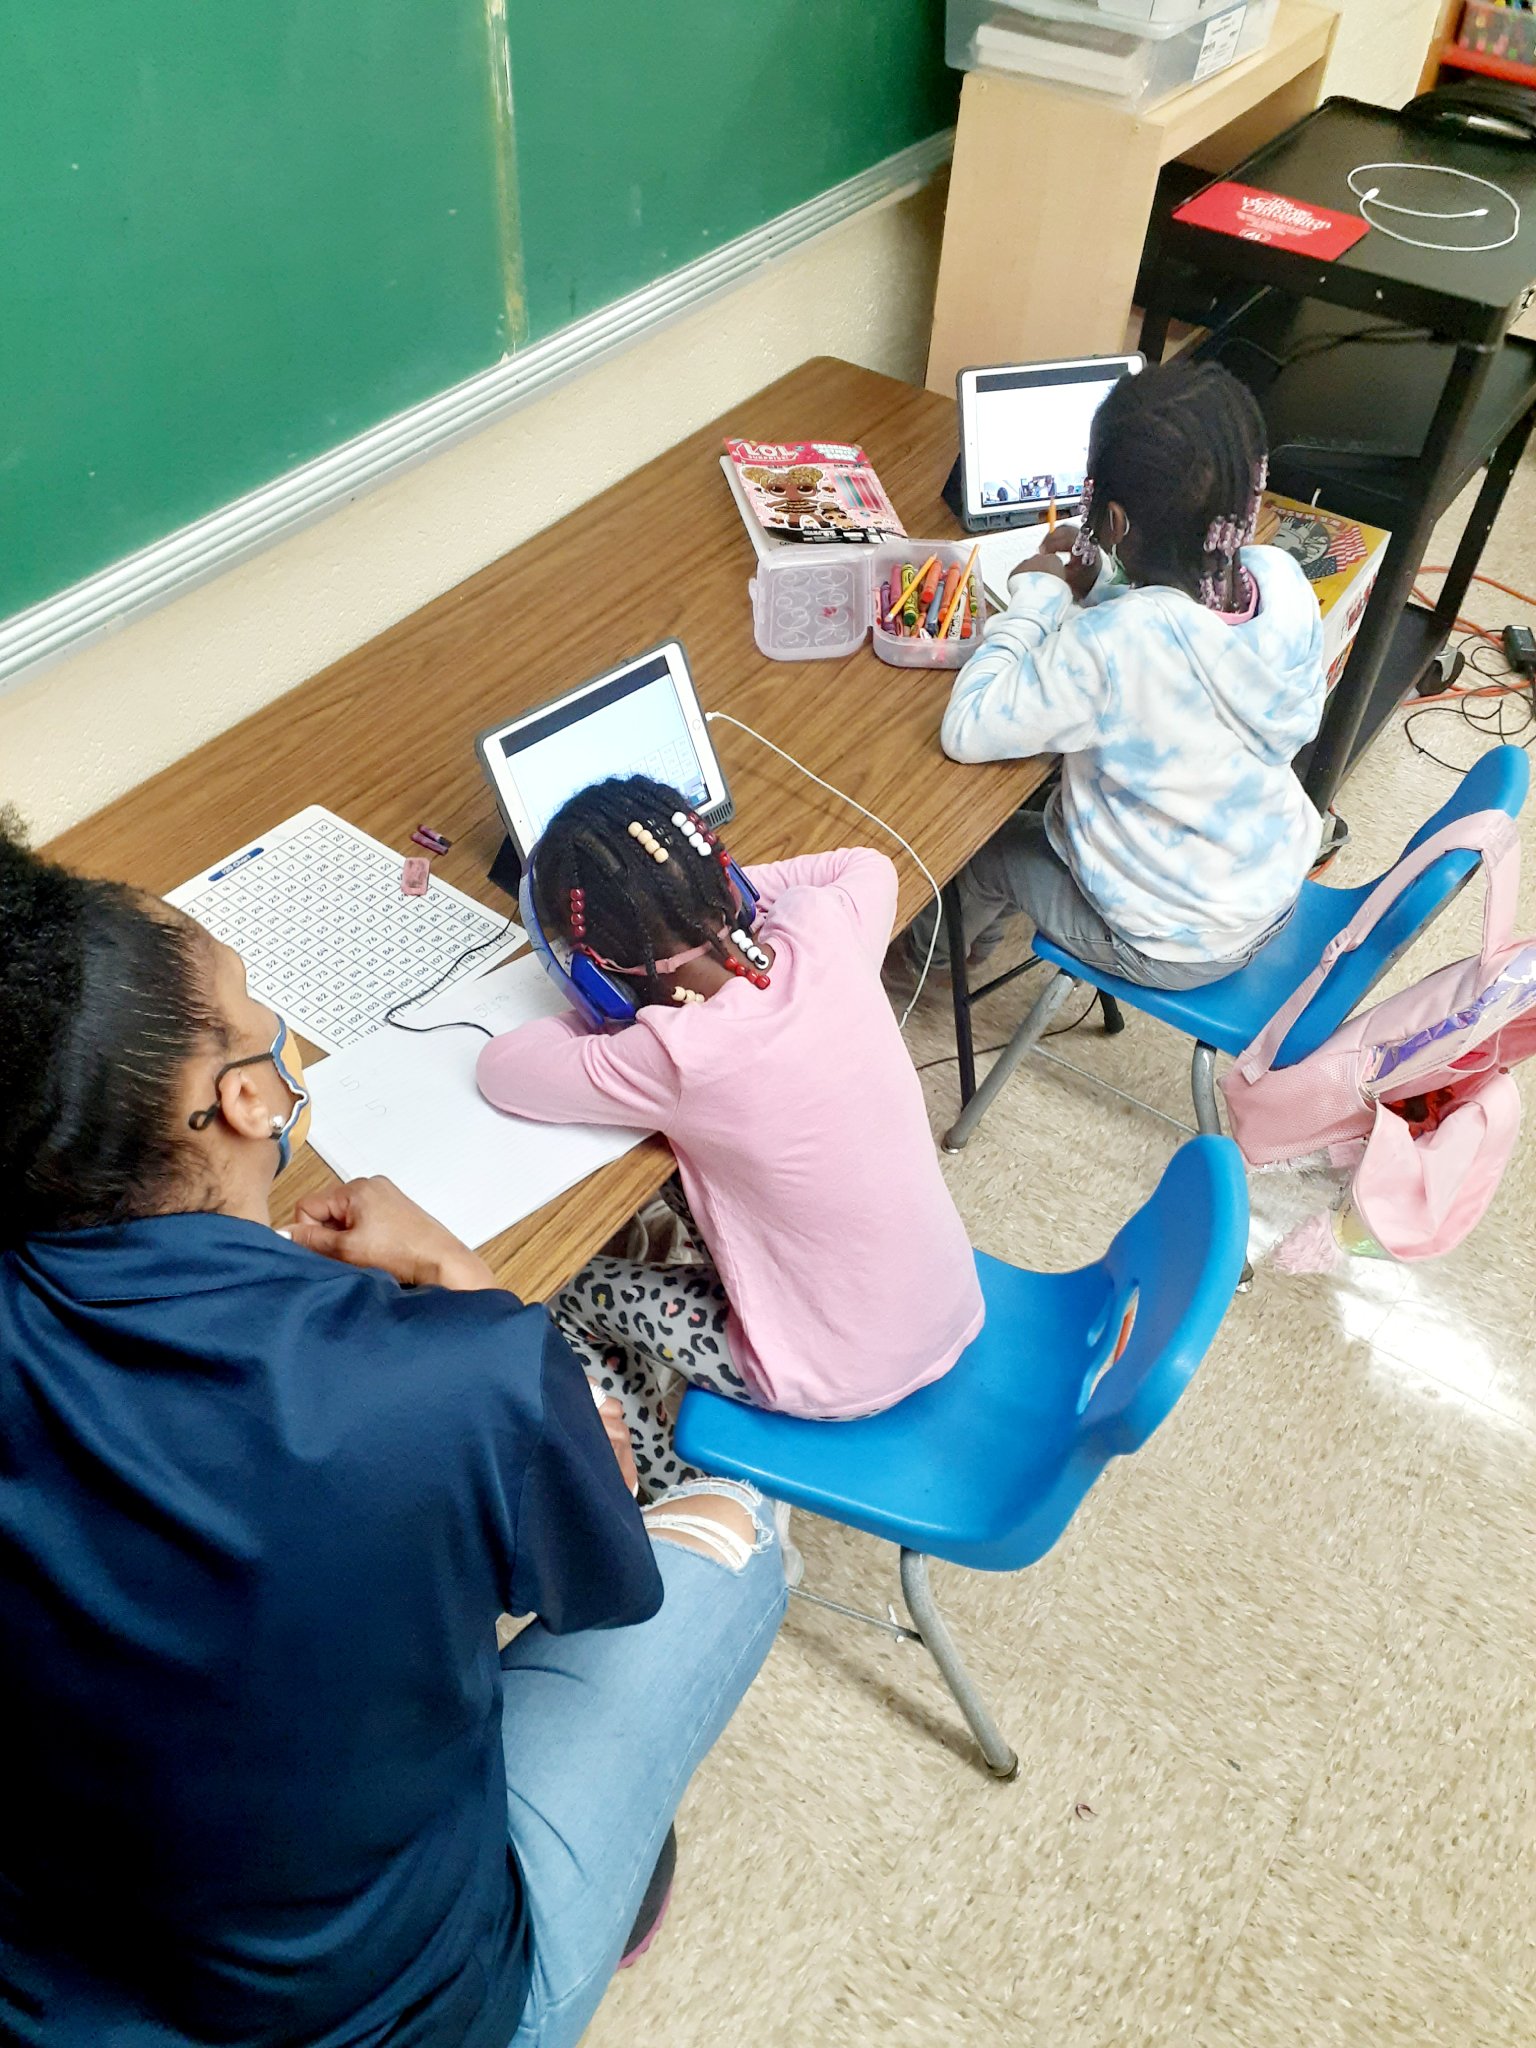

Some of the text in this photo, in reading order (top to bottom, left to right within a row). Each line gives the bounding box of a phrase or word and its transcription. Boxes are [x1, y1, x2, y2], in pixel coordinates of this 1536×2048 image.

[318, 824, 328, 832] 10
[202, 834, 345, 925] 12 13 14 15 16 17 18 19 20
[217, 843, 360, 937] 22 23 24 25 26 27 28 29 30
[233, 853, 376, 947] 32 33 34 35 36 37 38 39 40
[248, 863, 392, 957] 42 43 44 45 46 47 48 49 50
[265, 959, 279, 969] 52
[282, 948, 296, 958] 53
[300, 937, 312, 946] 54
[316, 925, 329, 935] 55
[333, 915, 345, 924] 56
[349, 903, 360, 913] 57
[365, 894, 377, 903] 58
[380, 882, 393, 892] 59
[266, 982, 277, 991] 61
[283, 970, 295, 979] 62
[300, 959, 312, 968] 63
[316, 947, 329, 957] 64
[333, 936, 345, 945] 65
[350, 925, 362, 935] 66
[366, 914, 376, 923] 67
[382, 904, 393, 913] 68
[281, 892, 440, 1003] 71 72 73 74 75 76 77 78 79 80
[299, 903, 457, 1014] 81 82 83 84 85 86 87 88 89 90
[316, 912, 474, 1024] 91 92 93 94 95 96 97 98 99 100
[331, 922, 490, 1037] 101 102 103 104 105 106 107 108 109 110
[364, 1024, 380, 1035] 112
[463, 955, 476, 963] 118
[339, 1073, 360, 1092] 5
[364, 1098, 387, 1117] 5
